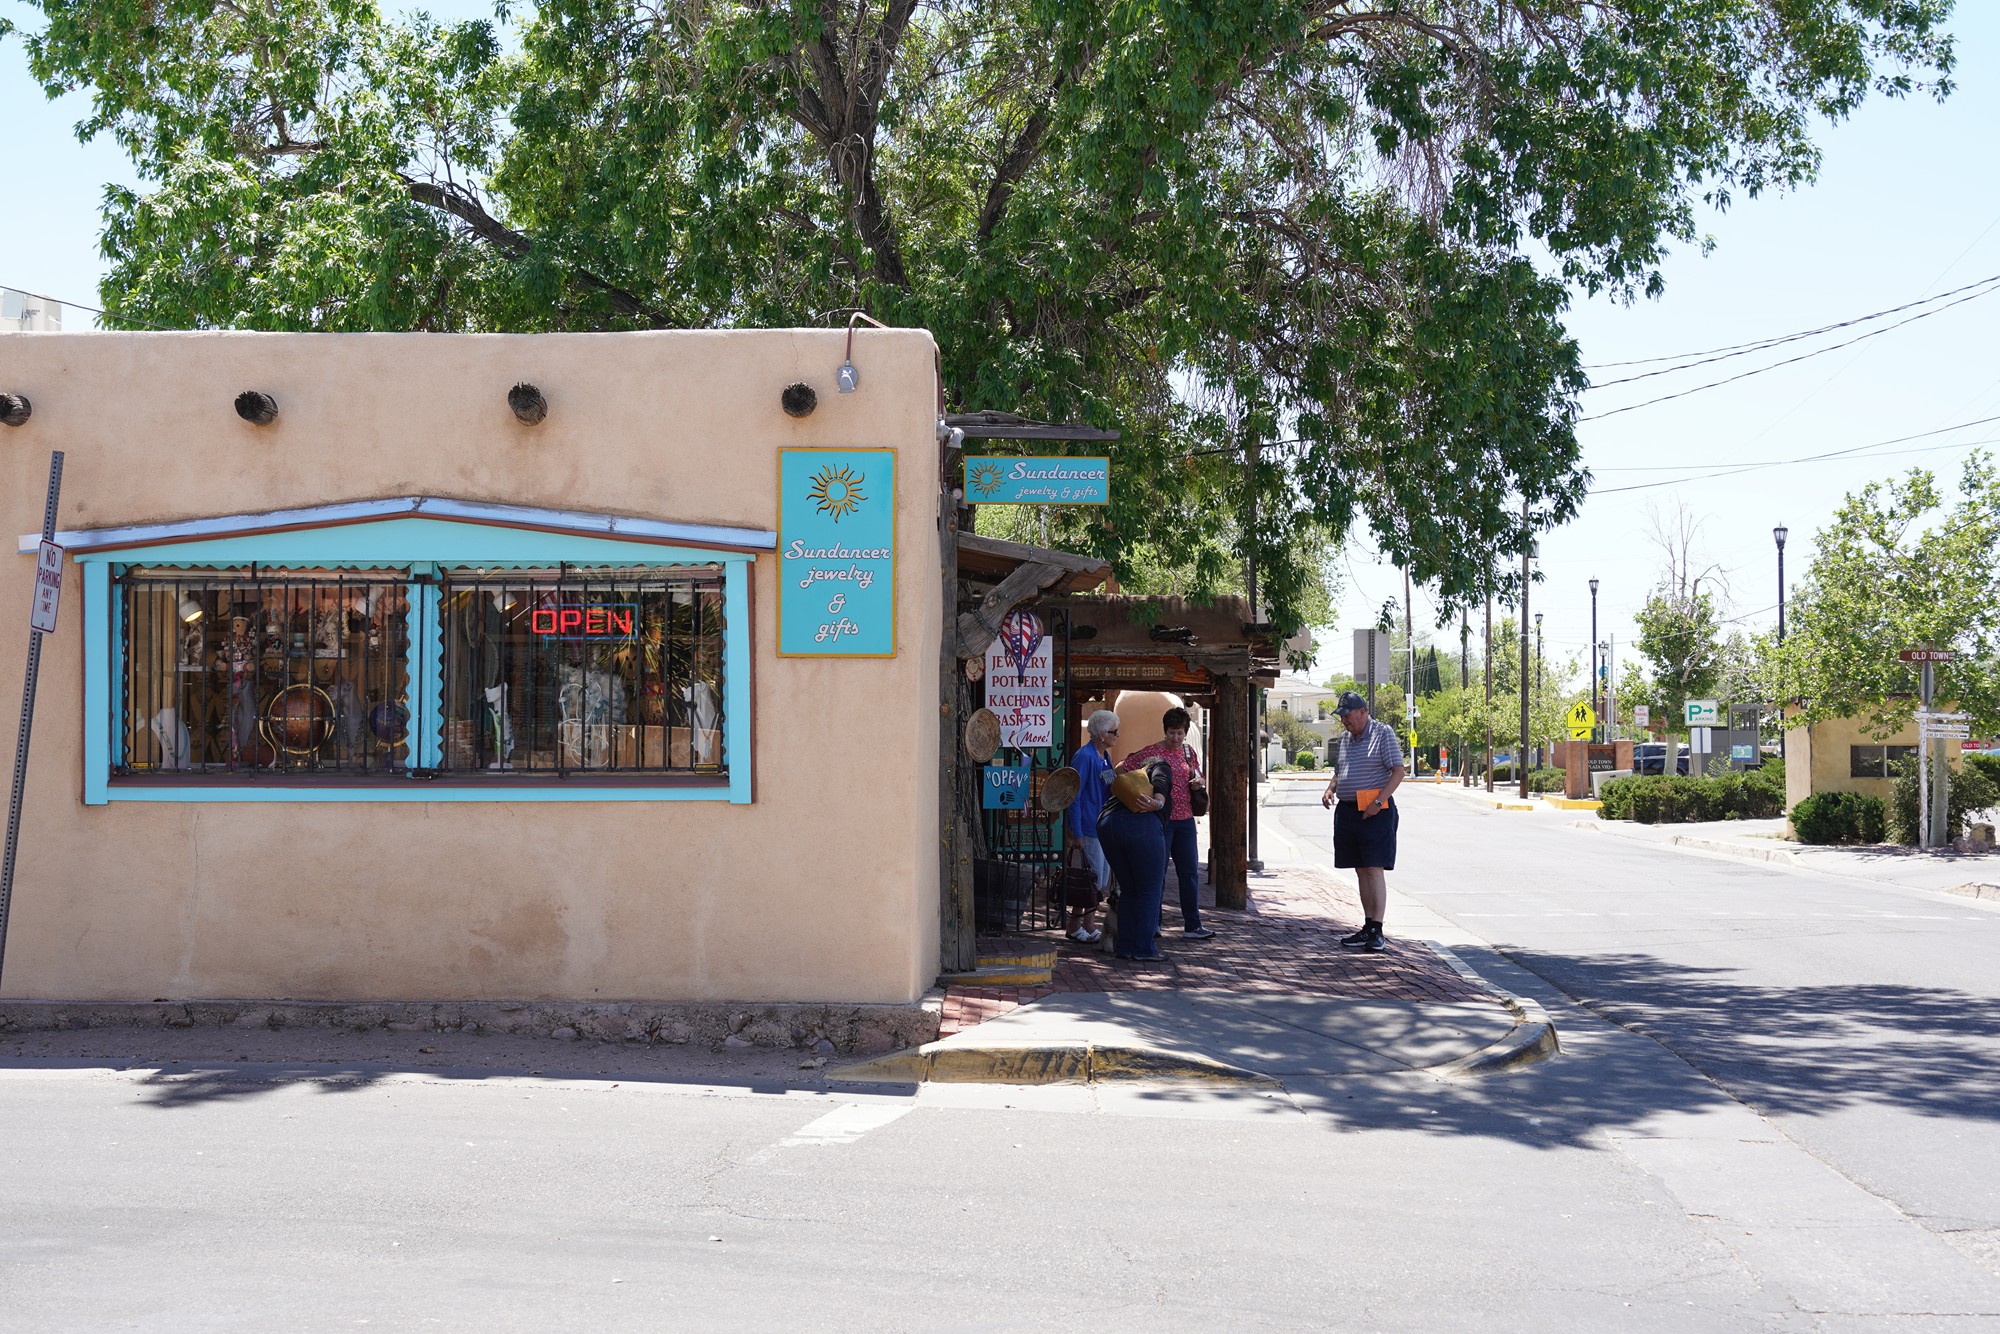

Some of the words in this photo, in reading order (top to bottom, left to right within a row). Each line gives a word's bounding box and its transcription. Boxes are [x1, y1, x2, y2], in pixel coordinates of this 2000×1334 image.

[1008, 461, 1106, 481] Sundancer
[1015, 485, 1058, 500] jewelry
[1060, 486, 1071, 499] &
[1072, 485, 1098, 500] gifts
[45, 549, 57, 567] NO
[784, 539, 890, 560] Sundancer
[37, 567, 61, 589] PARKING
[800, 564, 874, 589] jewelry
[42, 588, 52, 600] ANY
[40, 601, 51, 614] TIME
[828, 593, 846, 614] &
[532, 609, 631, 634] OPEN
[814, 618, 859, 643] gifts
[992, 656, 1048, 671] JEWRY
[1911, 651, 1926, 660] OLD
[1929, 651, 1949, 660] TOWN
[1116, 667, 1137, 677] GIFT
[1141, 667, 1165, 677] SHOP
[1020, 730, 1051, 745] More!
